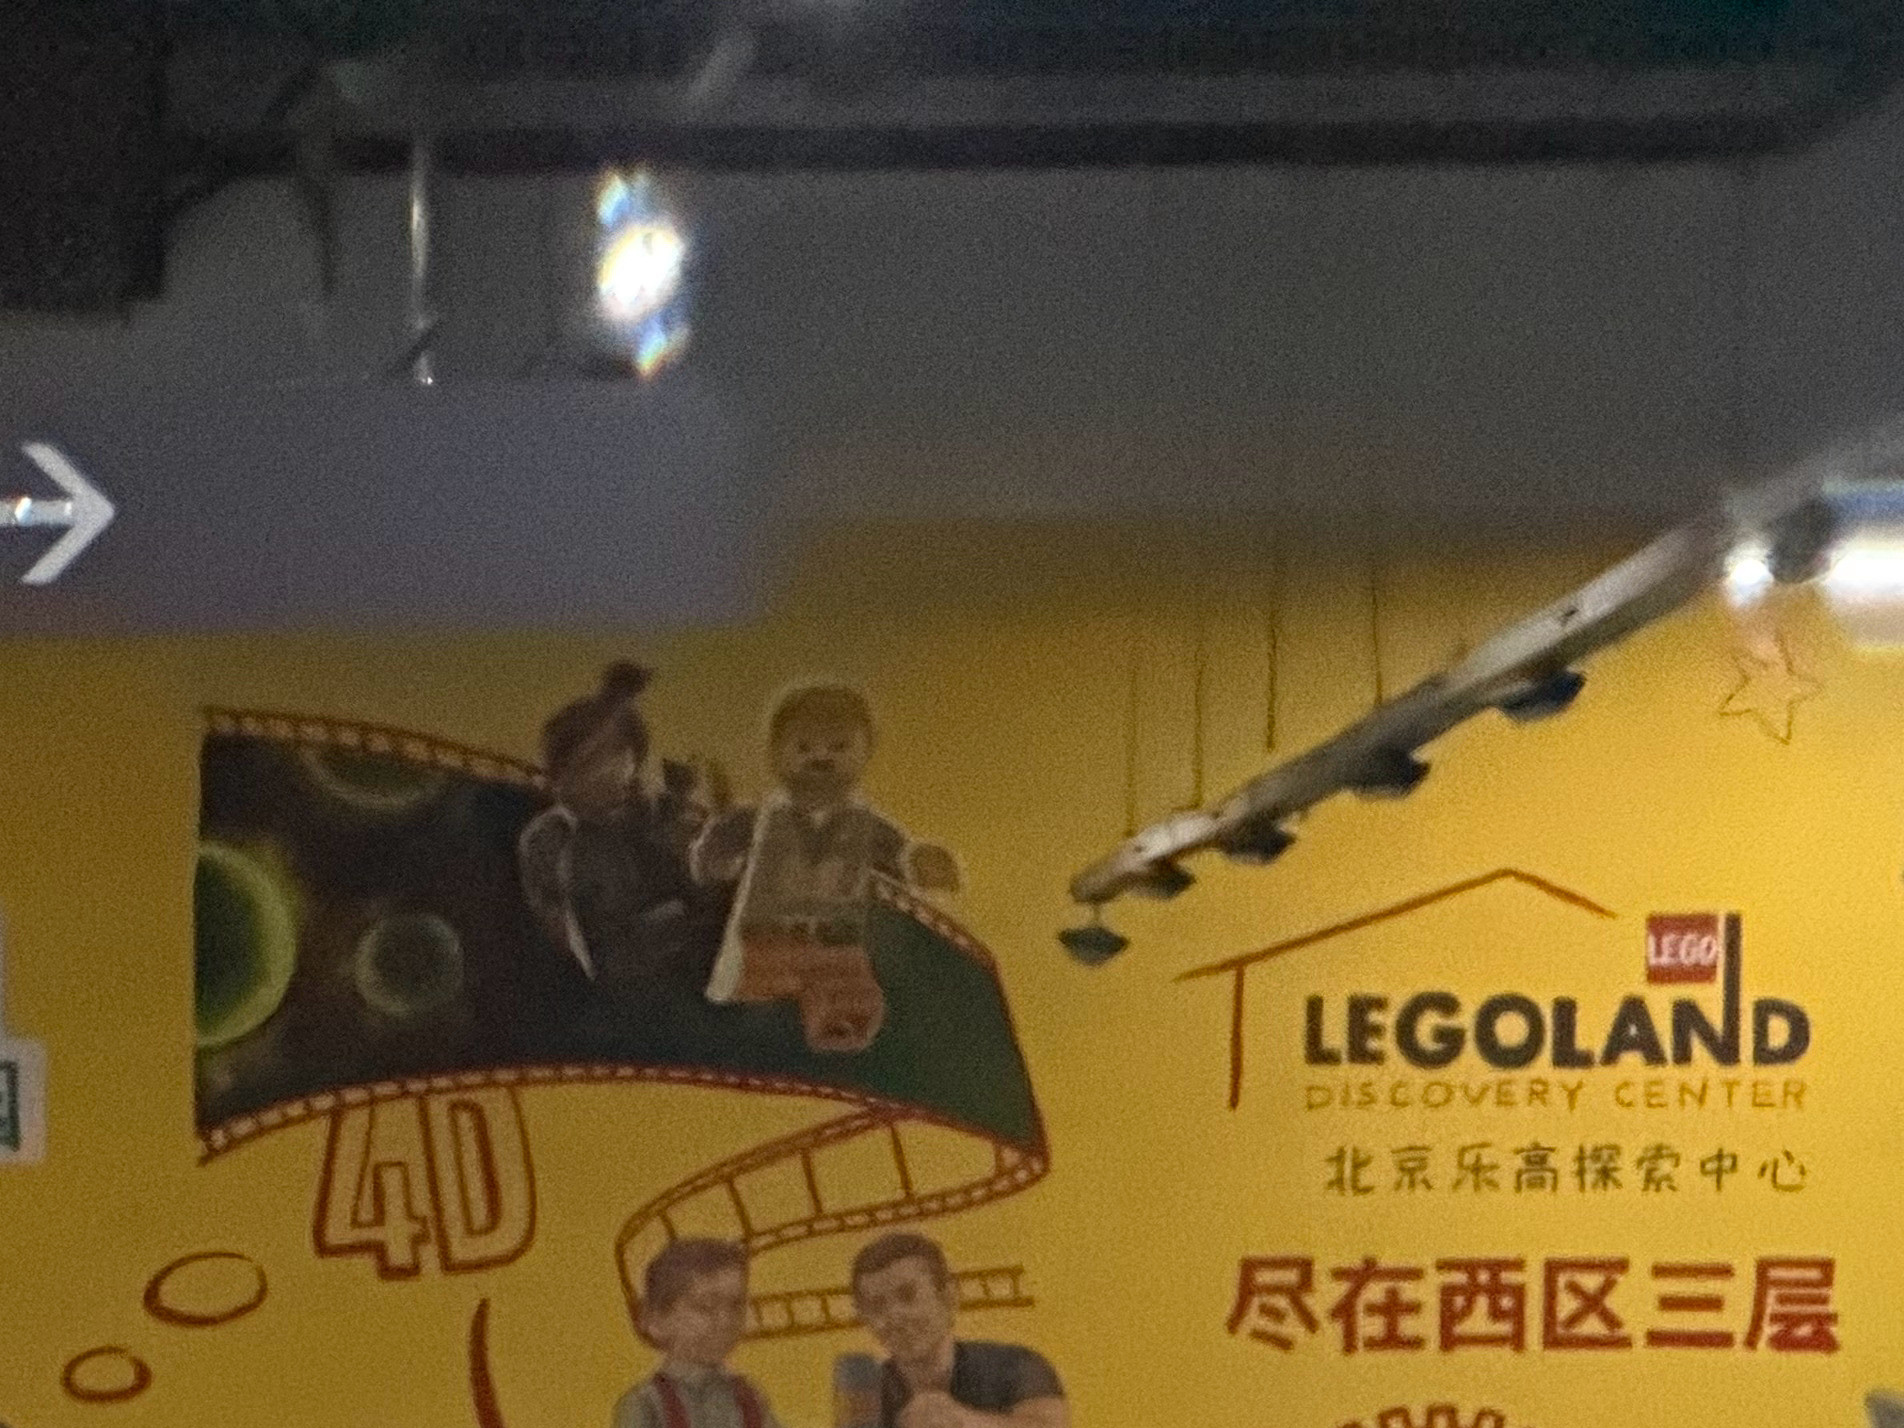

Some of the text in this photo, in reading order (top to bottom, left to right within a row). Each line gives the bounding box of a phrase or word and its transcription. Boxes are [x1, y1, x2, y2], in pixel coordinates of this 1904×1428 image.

[1647, 932, 1720, 968] LEGO
[1303, 913, 1812, 1069] LEGOLAND
[1305, 1078, 1810, 1112] DISCOVERY CENTER
[313, 1087, 538, 1282] 4D
[1324, 1141, 1810, 1194] 北京乐高探索中心
[1225, 1255, 1841, 1355] 尽在西区三层
